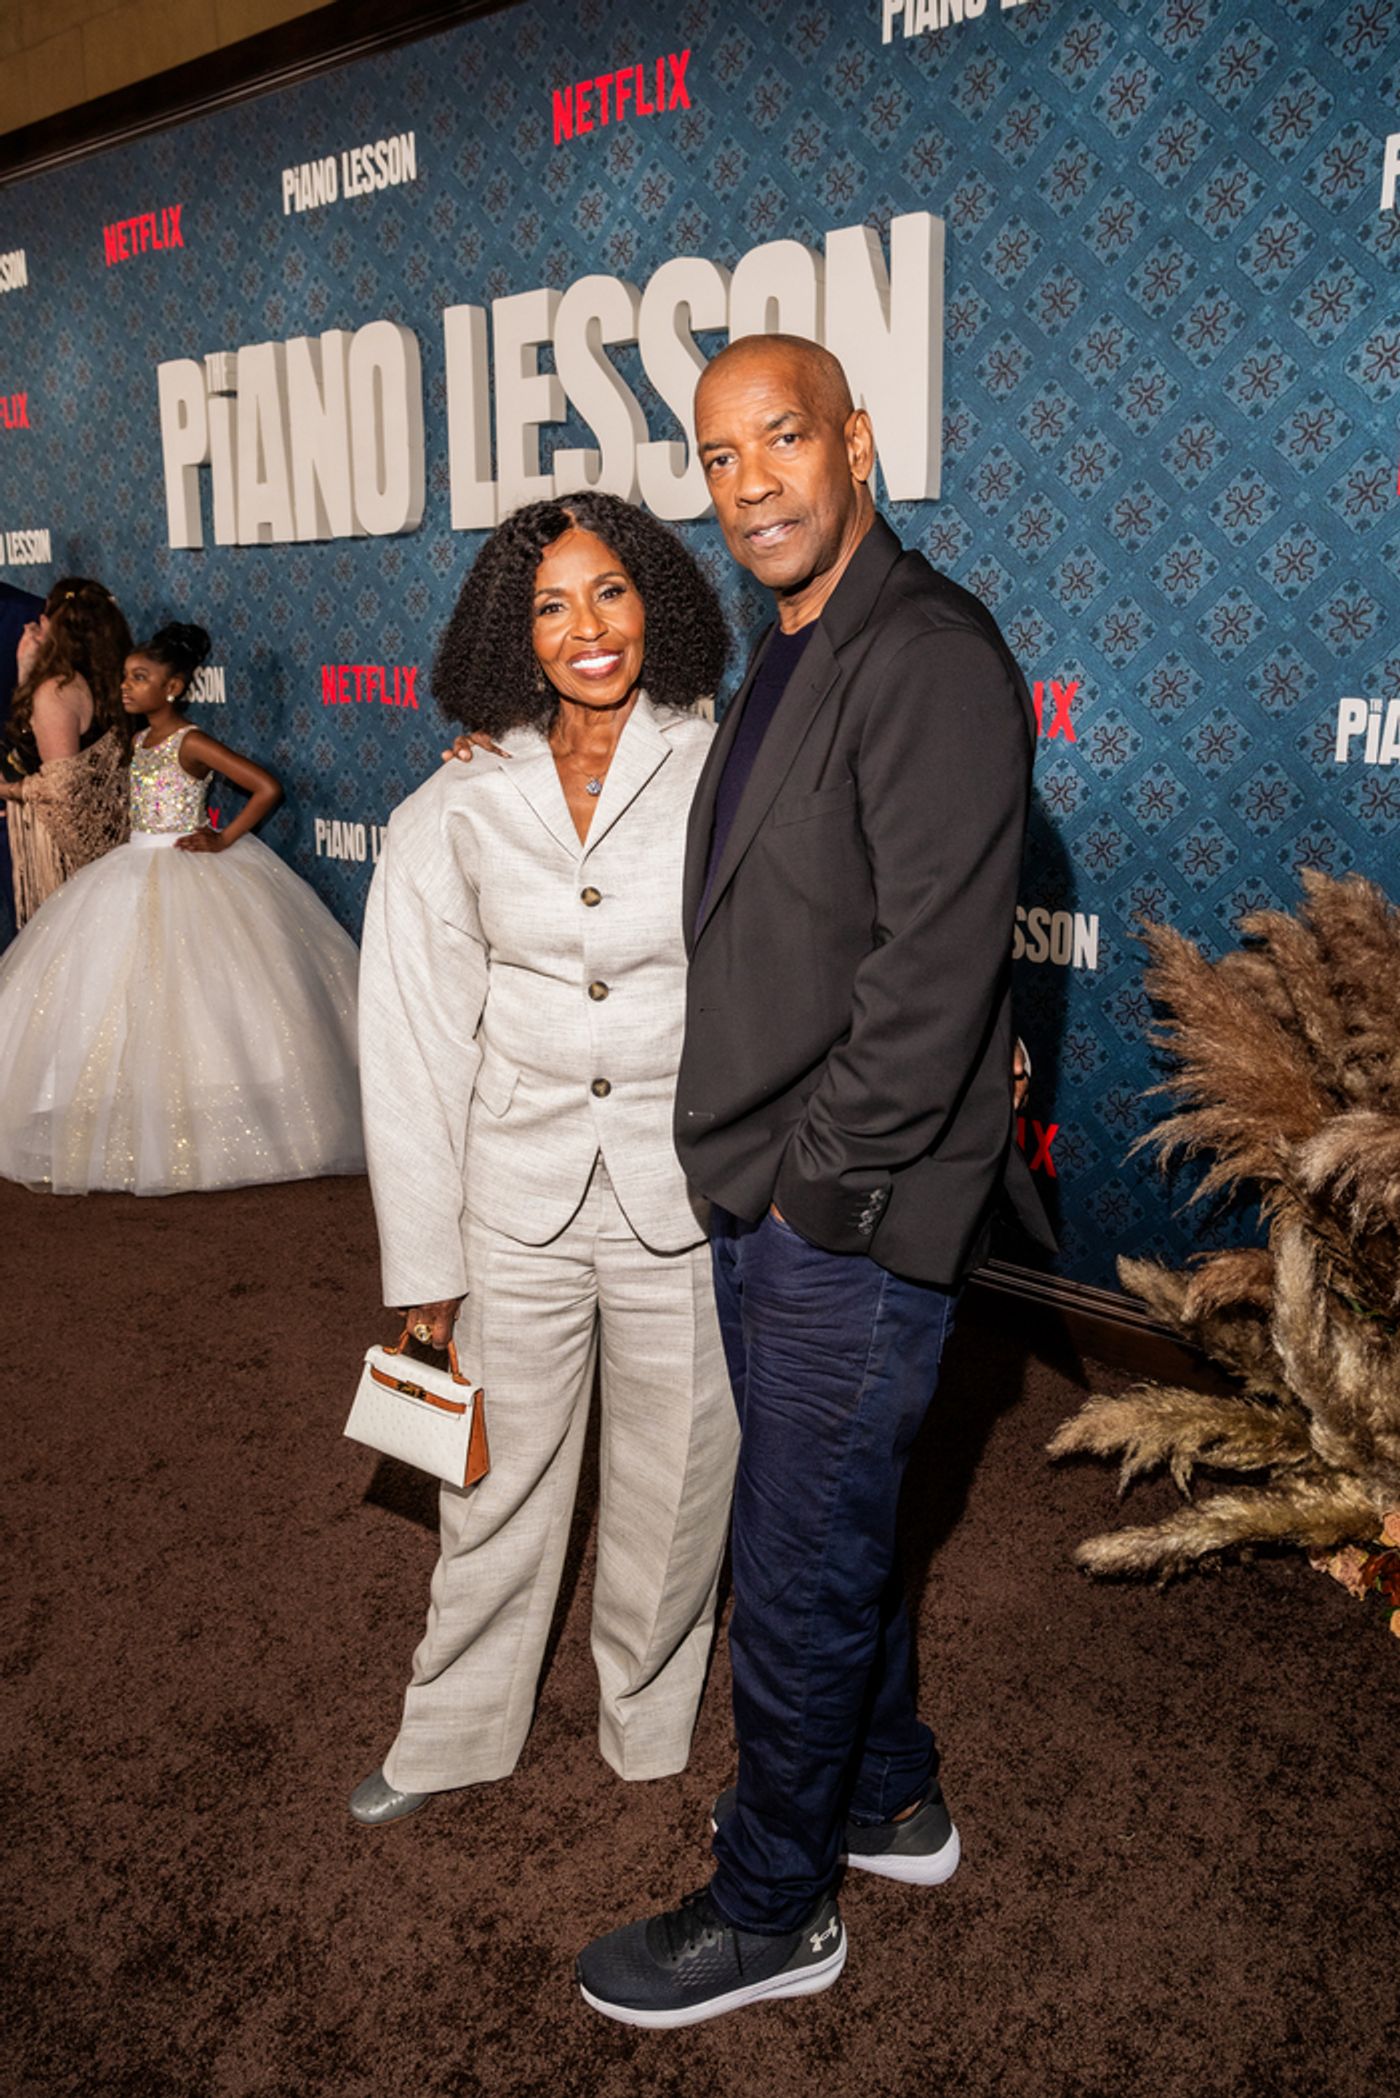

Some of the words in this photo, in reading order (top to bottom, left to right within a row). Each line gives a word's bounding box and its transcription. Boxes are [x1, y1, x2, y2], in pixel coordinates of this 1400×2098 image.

[552, 48, 691, 145] NETFLIX
[341, 131, 417, 199] LESSON
[103, 203, 184, 268] NETFLIX
[6, 528, 52, 566] LESSON
[322, 664, 419, 711] NETFLIX
